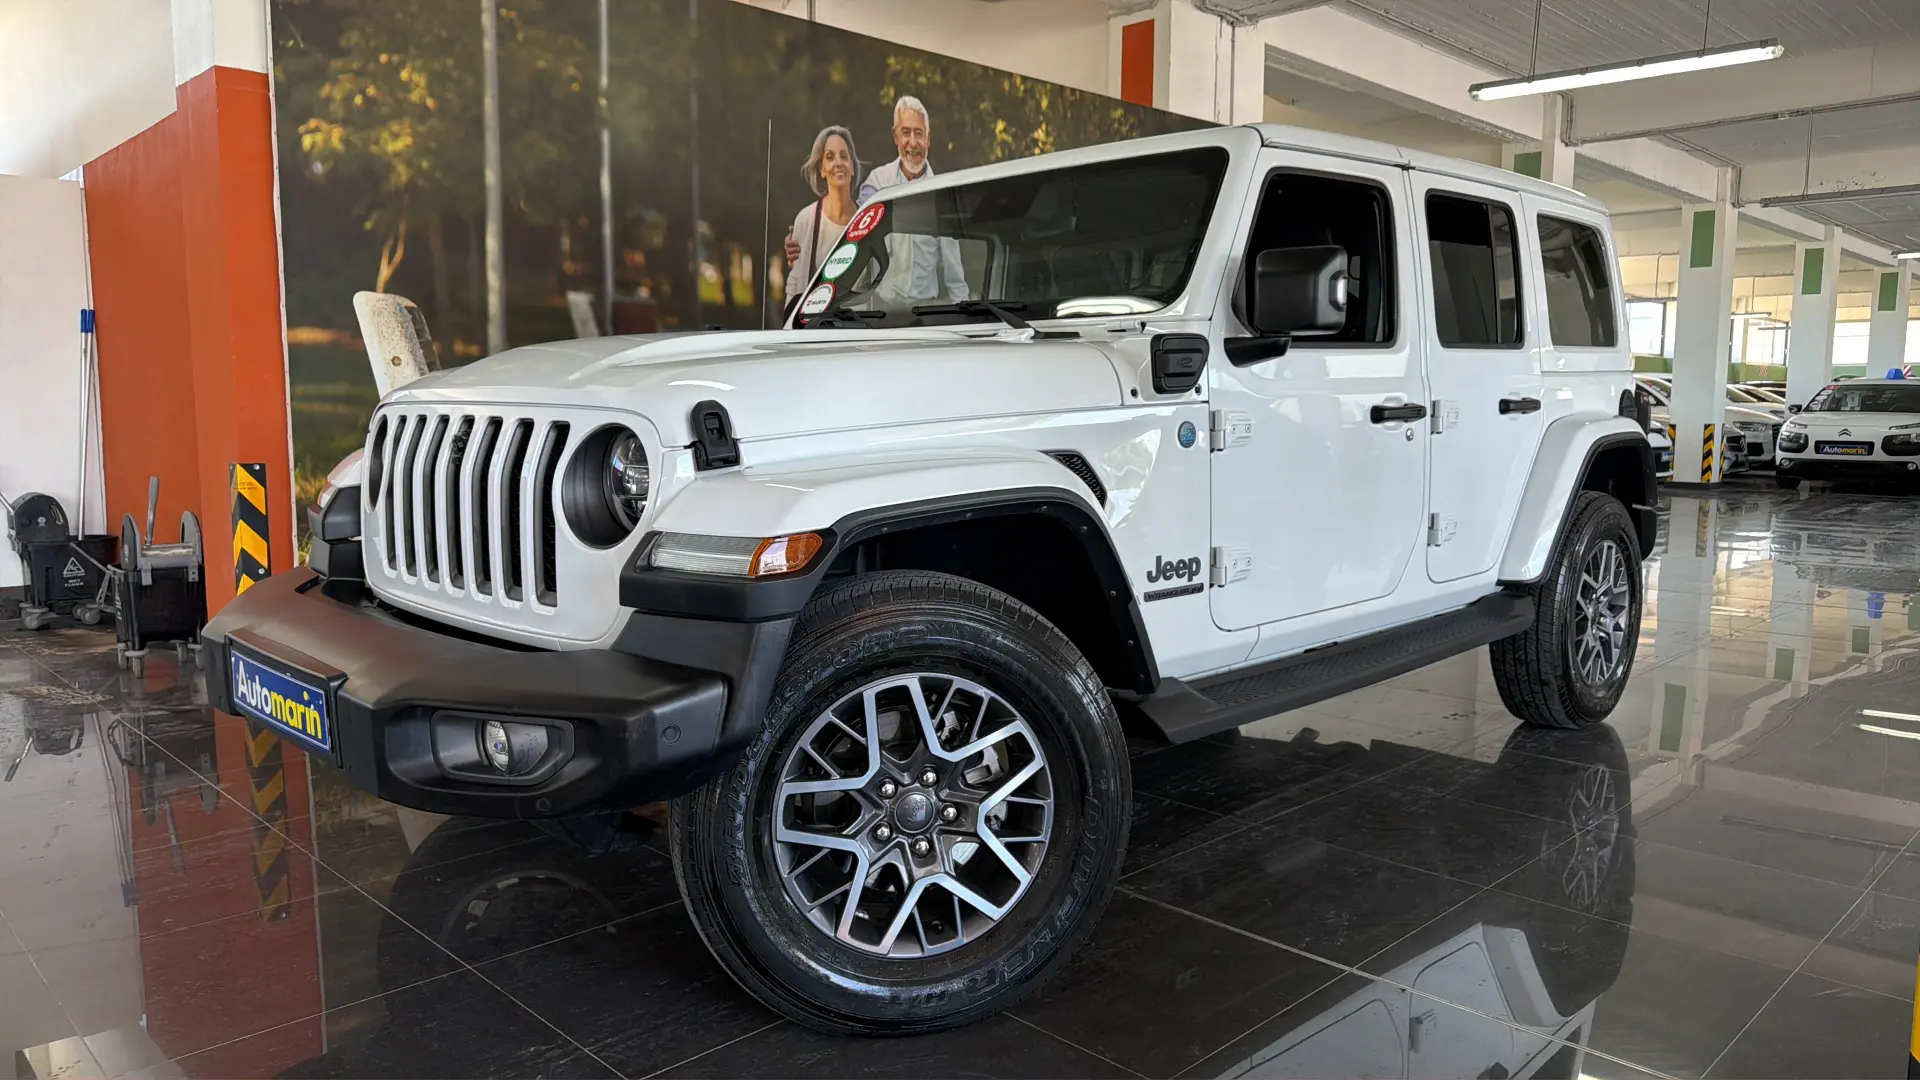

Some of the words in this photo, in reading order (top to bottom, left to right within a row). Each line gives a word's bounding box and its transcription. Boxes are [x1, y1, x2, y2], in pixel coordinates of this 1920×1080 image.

[859, 211, 875, 229] 6
[828, 257, 852, 265] HYBRID
[1823, 445, 1865, 455] Automarin
[1146, 555, 1202, 584] Jeep
[1148, 588, 1190, 599] WRANGLER
[236, 660, 323, 740] Automarin
